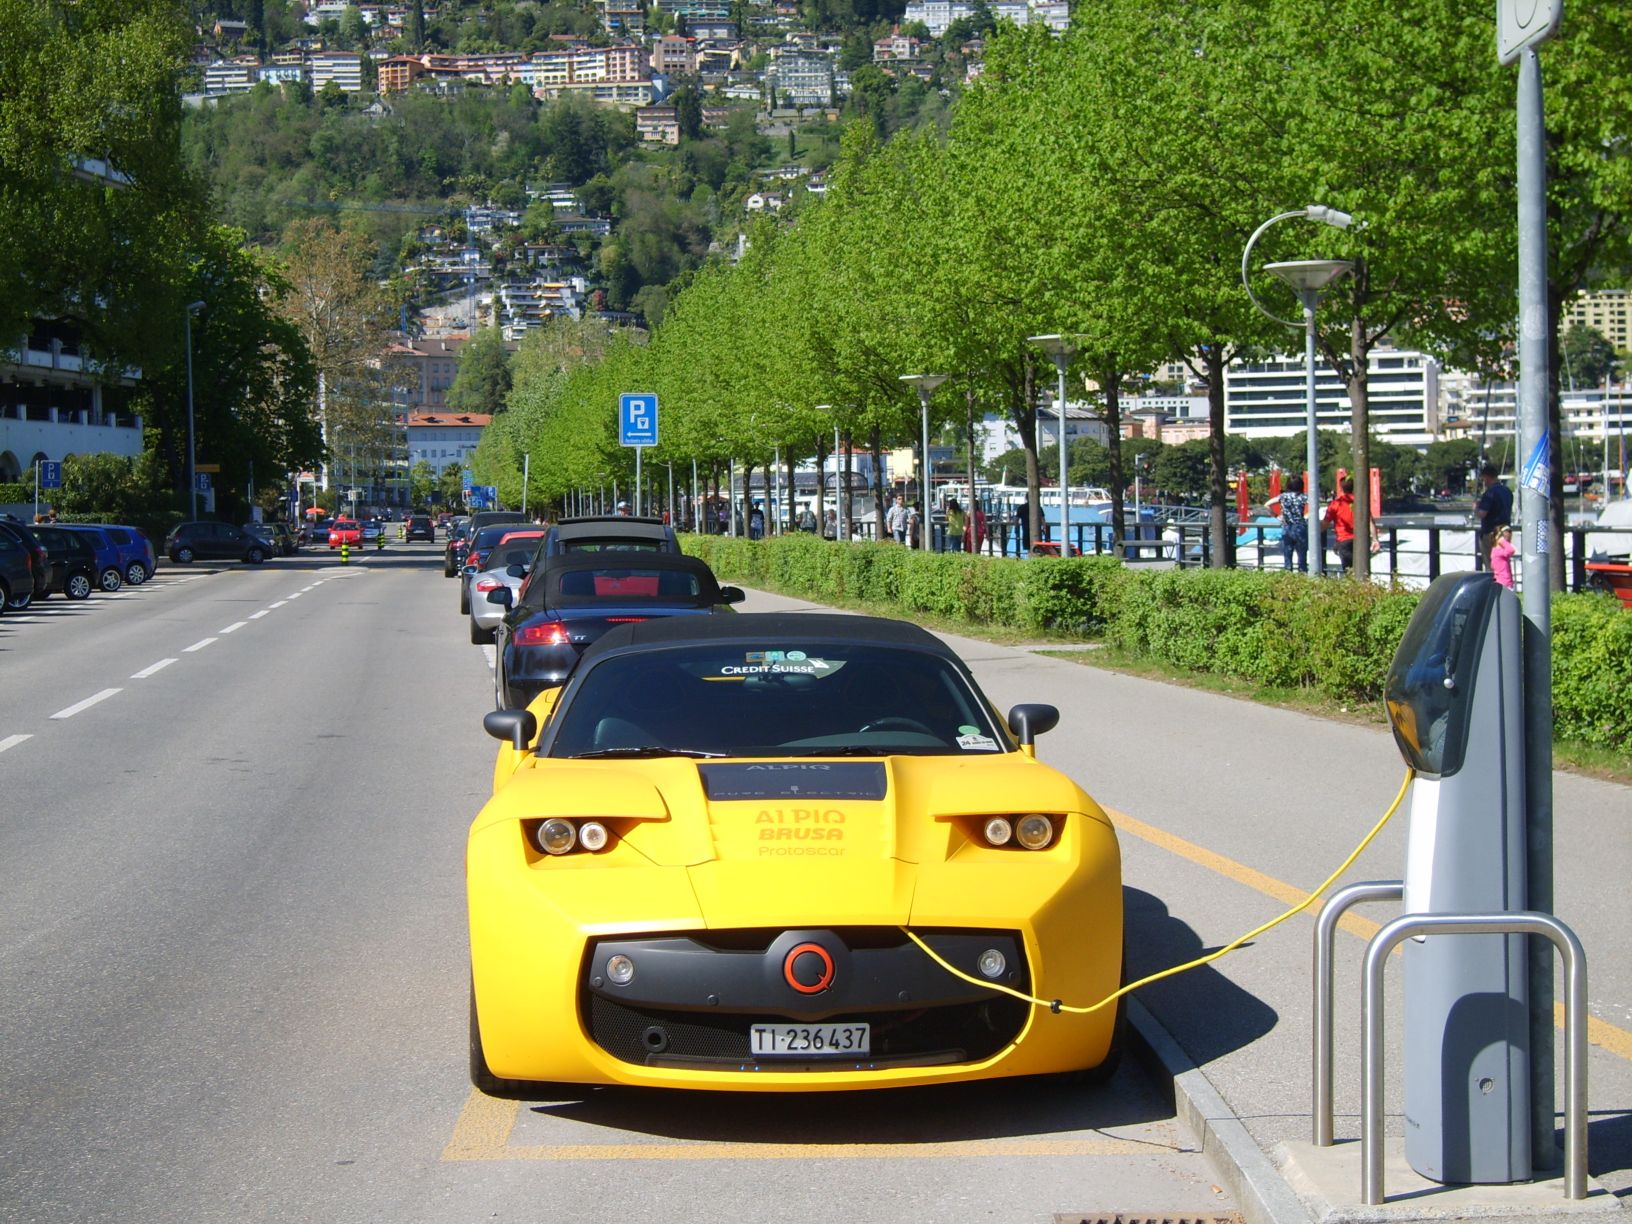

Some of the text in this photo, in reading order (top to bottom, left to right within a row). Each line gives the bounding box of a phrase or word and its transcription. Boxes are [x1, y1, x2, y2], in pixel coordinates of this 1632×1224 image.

[630, 400, 645, 423] P
[721, 664, 815, 675] CREDIT SUISSE
[758, 828, 844, 840] BRUSA
[758, 846, 846, 857] Protoscar
